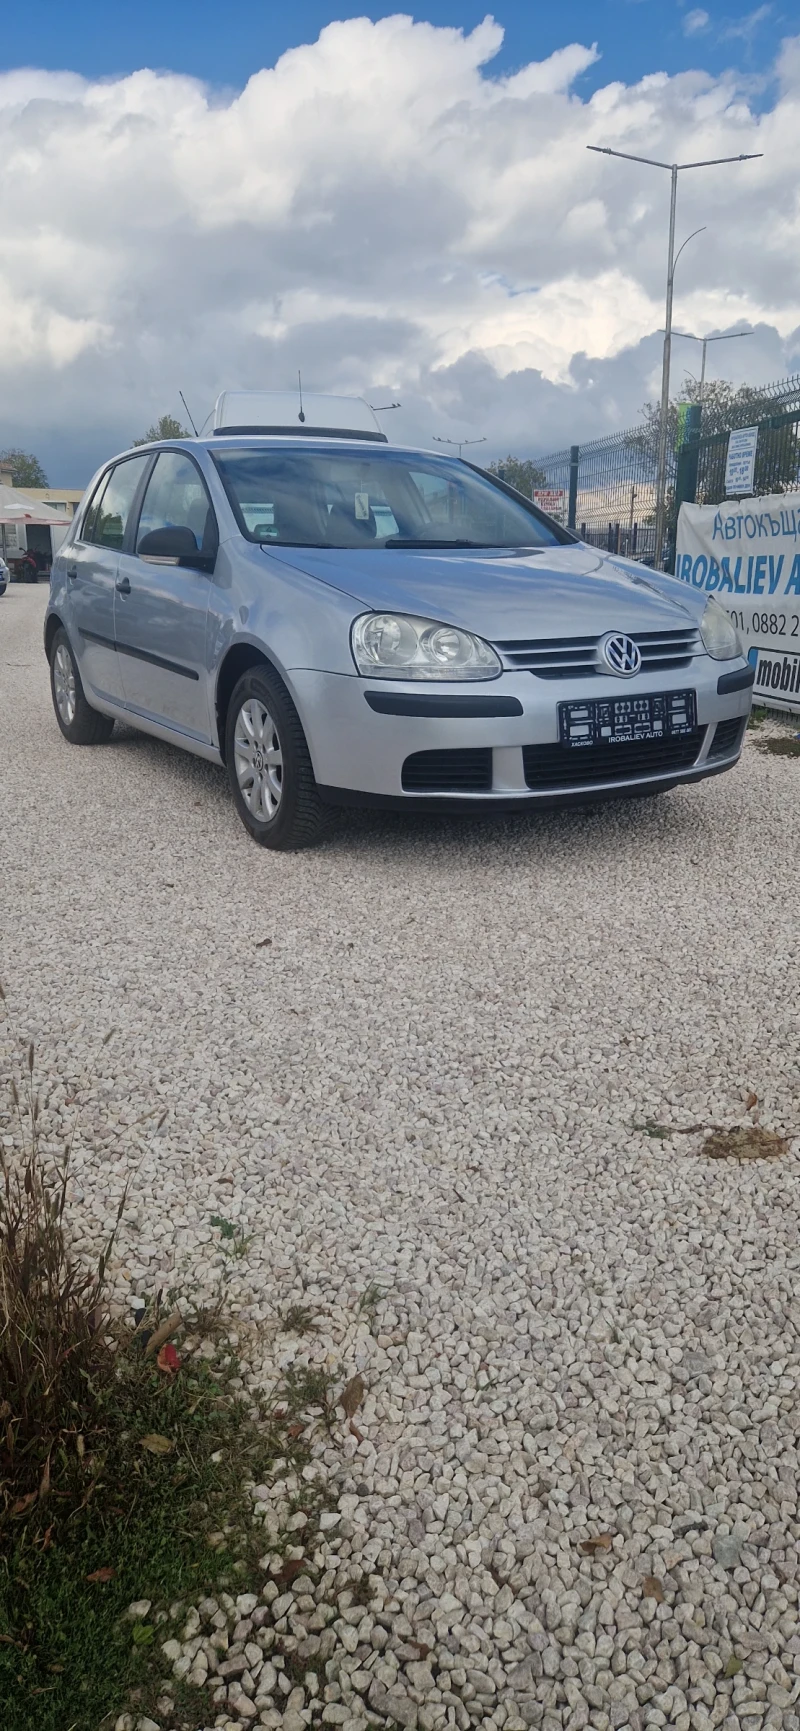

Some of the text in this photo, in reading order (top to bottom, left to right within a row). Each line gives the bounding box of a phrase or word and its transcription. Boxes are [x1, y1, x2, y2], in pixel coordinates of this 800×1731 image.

[676, 553, 785, 595] IROBALIEV
[752, 612, 787, 636] 0882
[608, 732, 645, 743] IROBALIEV
[645, 730, 664, 739] AUTO
